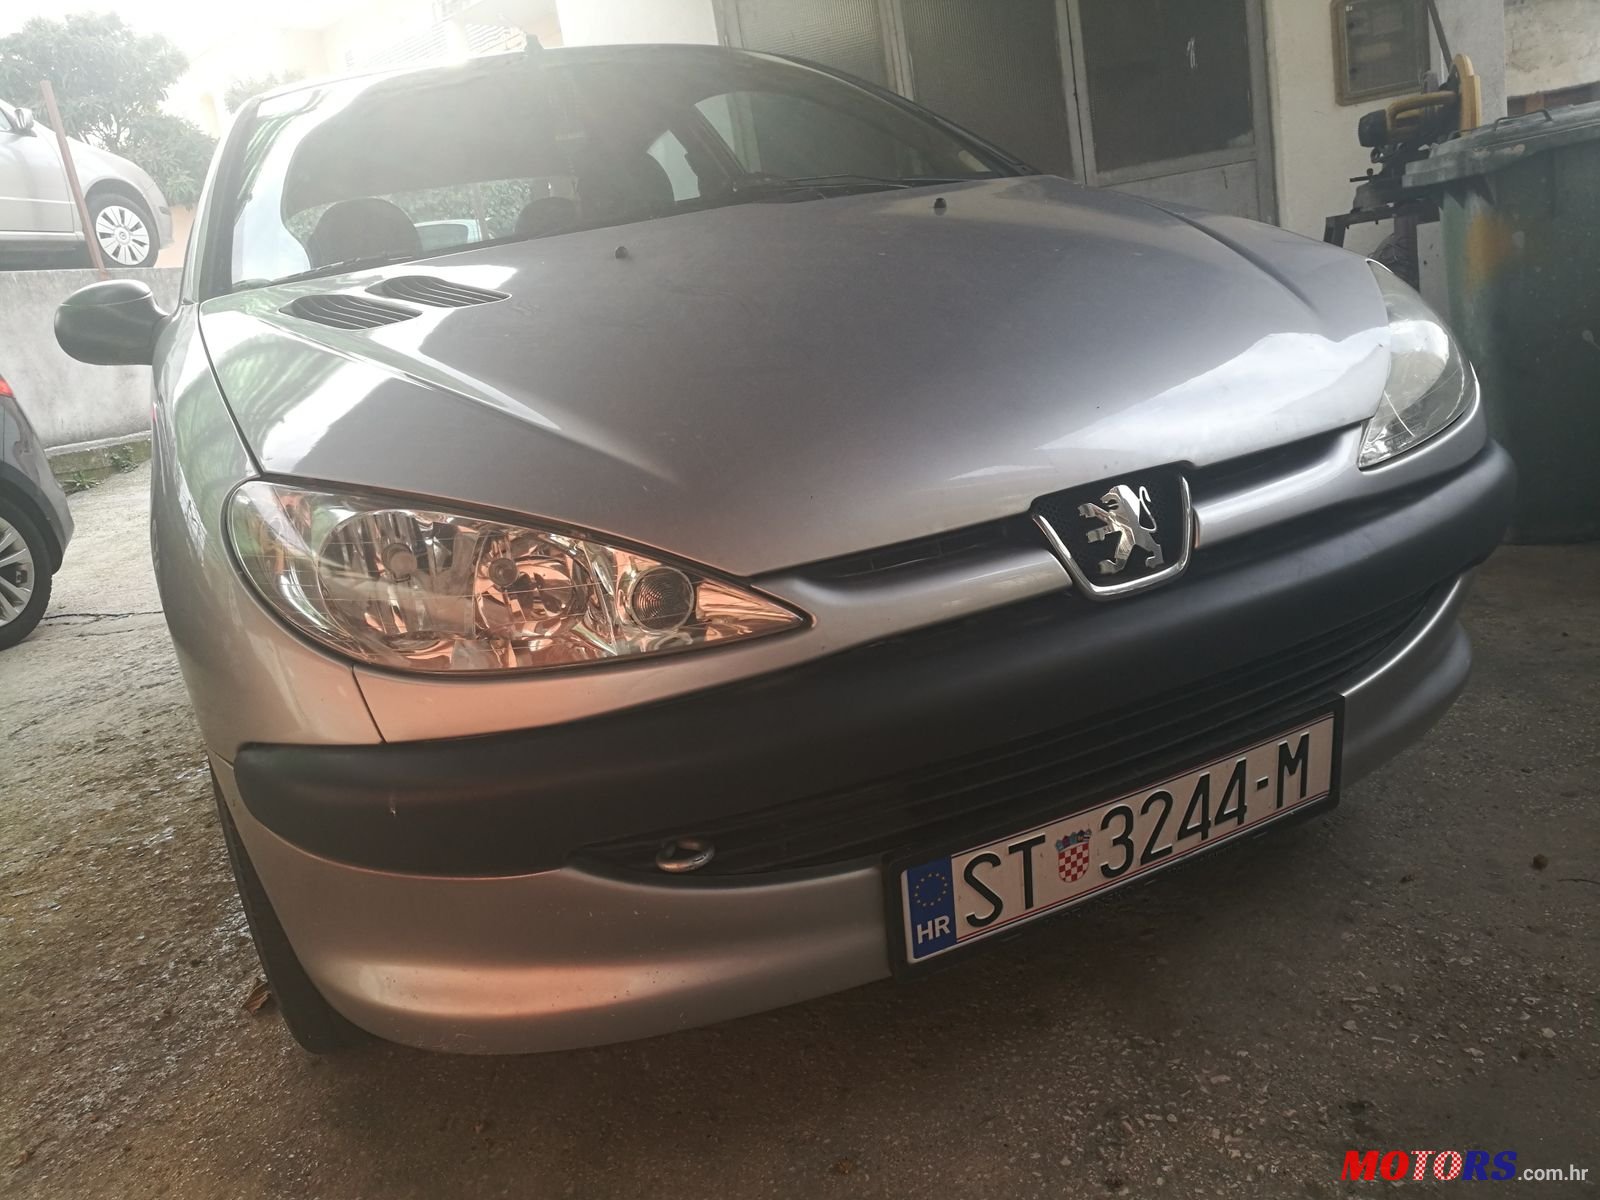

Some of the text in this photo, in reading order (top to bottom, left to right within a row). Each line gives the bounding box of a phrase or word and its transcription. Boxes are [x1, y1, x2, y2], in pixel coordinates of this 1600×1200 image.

[962, 732, 1309, 928] ST 3244-M
[917, 914, 950, 944] HR
